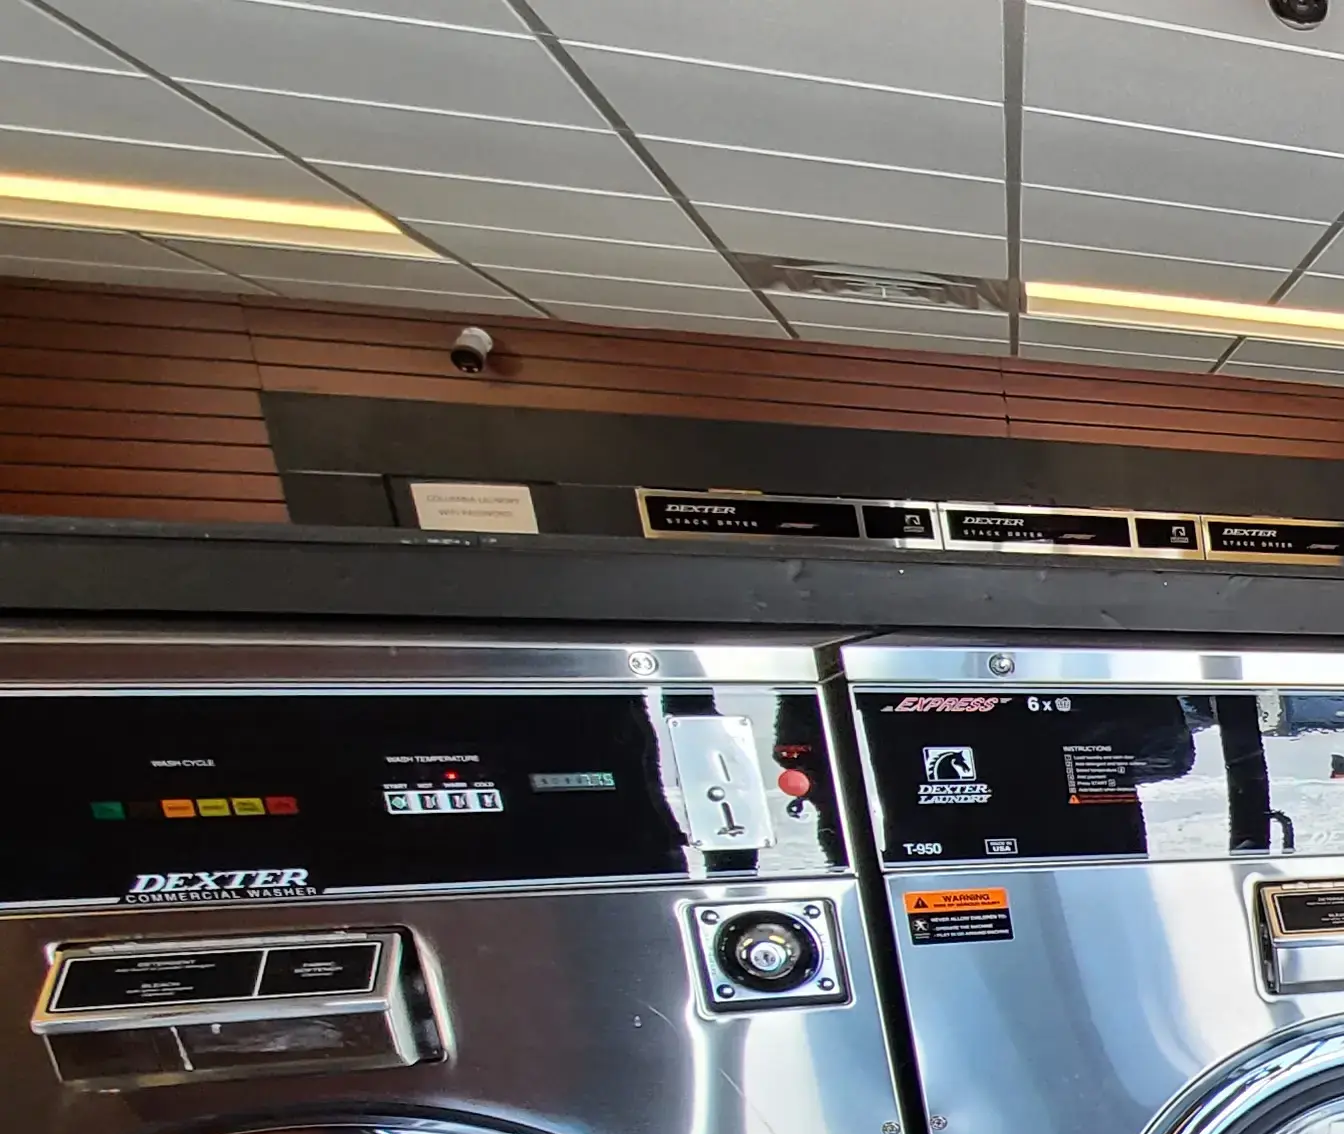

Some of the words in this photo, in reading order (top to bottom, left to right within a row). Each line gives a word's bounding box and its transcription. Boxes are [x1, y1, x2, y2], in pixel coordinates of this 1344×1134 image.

[665, 504, 736, 515] DEXTER
[666, 517, 709, 526] STACK
[962, 516, 1025, 527] DEXTER
[964, 529, 1000, 537] STACK
[1222, 528, 1278, 538] DEXTER
[895, 697, 999, 712] EXPRESS
[1027, 696, 1039, 712] 6
[1043, 700, 1052, 712] x
[182, 759, 216, 767] CYCLE
[414, 754, 480, 763] TEMPERATURE
[918, 783, 989, 794] DEXTER
[918, 794, 992, 804] LAUNDRY
[903, 842, 942, 854] T-950
[129, 868, 309, 893] DEXTER
[126, 889, 241, 904] COMMERCIAL
[247, 886, 317, 898] WASHER
[942, 894, 990, 903] WARNING
